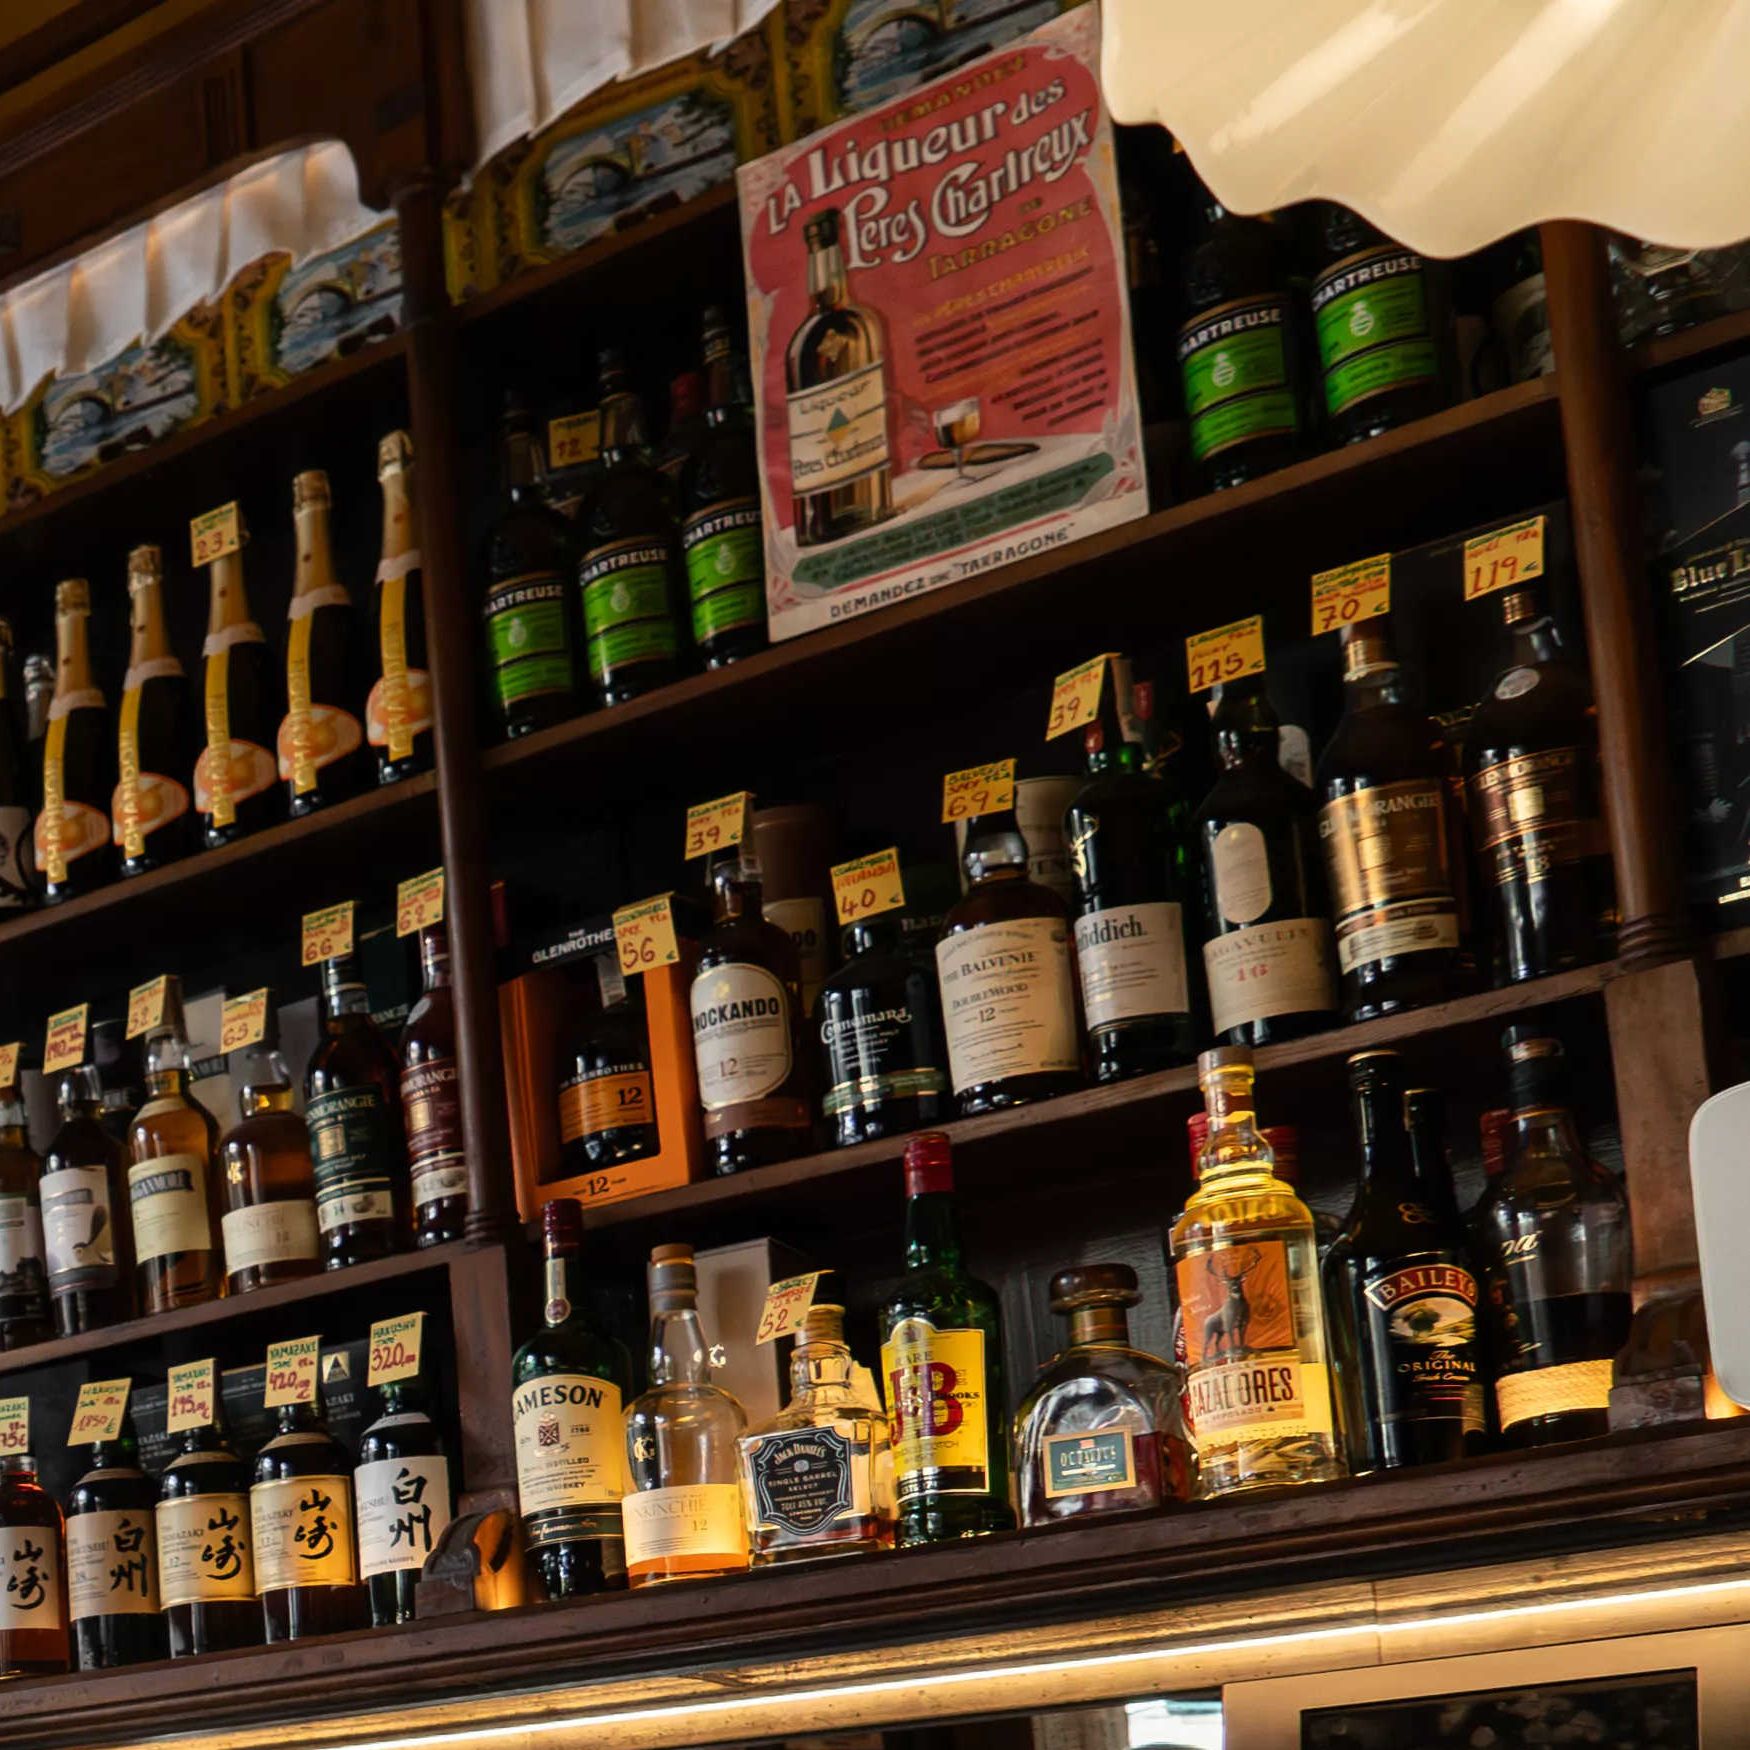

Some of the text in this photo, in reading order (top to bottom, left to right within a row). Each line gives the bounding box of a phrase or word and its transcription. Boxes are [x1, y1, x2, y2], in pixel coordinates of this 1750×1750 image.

[766, 77, 1067, 235] LA Liqueur des
[928, 196, 1094, 281] TARRAGONE
[1470, 556, 1518, 594] 119
[1671, 562, 1729, 593] Blue
[830, 575, 925, 619] DEMANDEZ
[1318, 598, 1360, 630] 70
[1190, 652, 1244, 689] 115
[948, 790, 990, 818] 69
[689, 826, 720, 852] 39
[841, 888, 876, 917] 40
[531, 927, 616, 964] GLENROTHE
[622, 936, 655, 970] 56
[960, 950, 1036, 977] BALVENIE
[1237, 963, 1268, 982] 16
[977, 1007, 997, 1023] 12
[719, 1057, 738, 1078] 12
[618, 1086, 643, 1107] 12
[587, 1176, 610, 1197] 12
[1378, 1265, 1477, 1303] BAILEYS
[759, 1308, 788, 1339] 52
[1396, 1358, 1477, 1374] ORIGINAL
[513, 1384, 605, 1420] AMESON
[1191, 1366, 1296, 1419] CAZADORES
[773, 1448, 792, 1465] JACK
[767, 1471, 838, 1488] SINGLE BARREL
[787, 1482, 818, 1492] SELECT
[692, 1519, 708, 1532] 12
